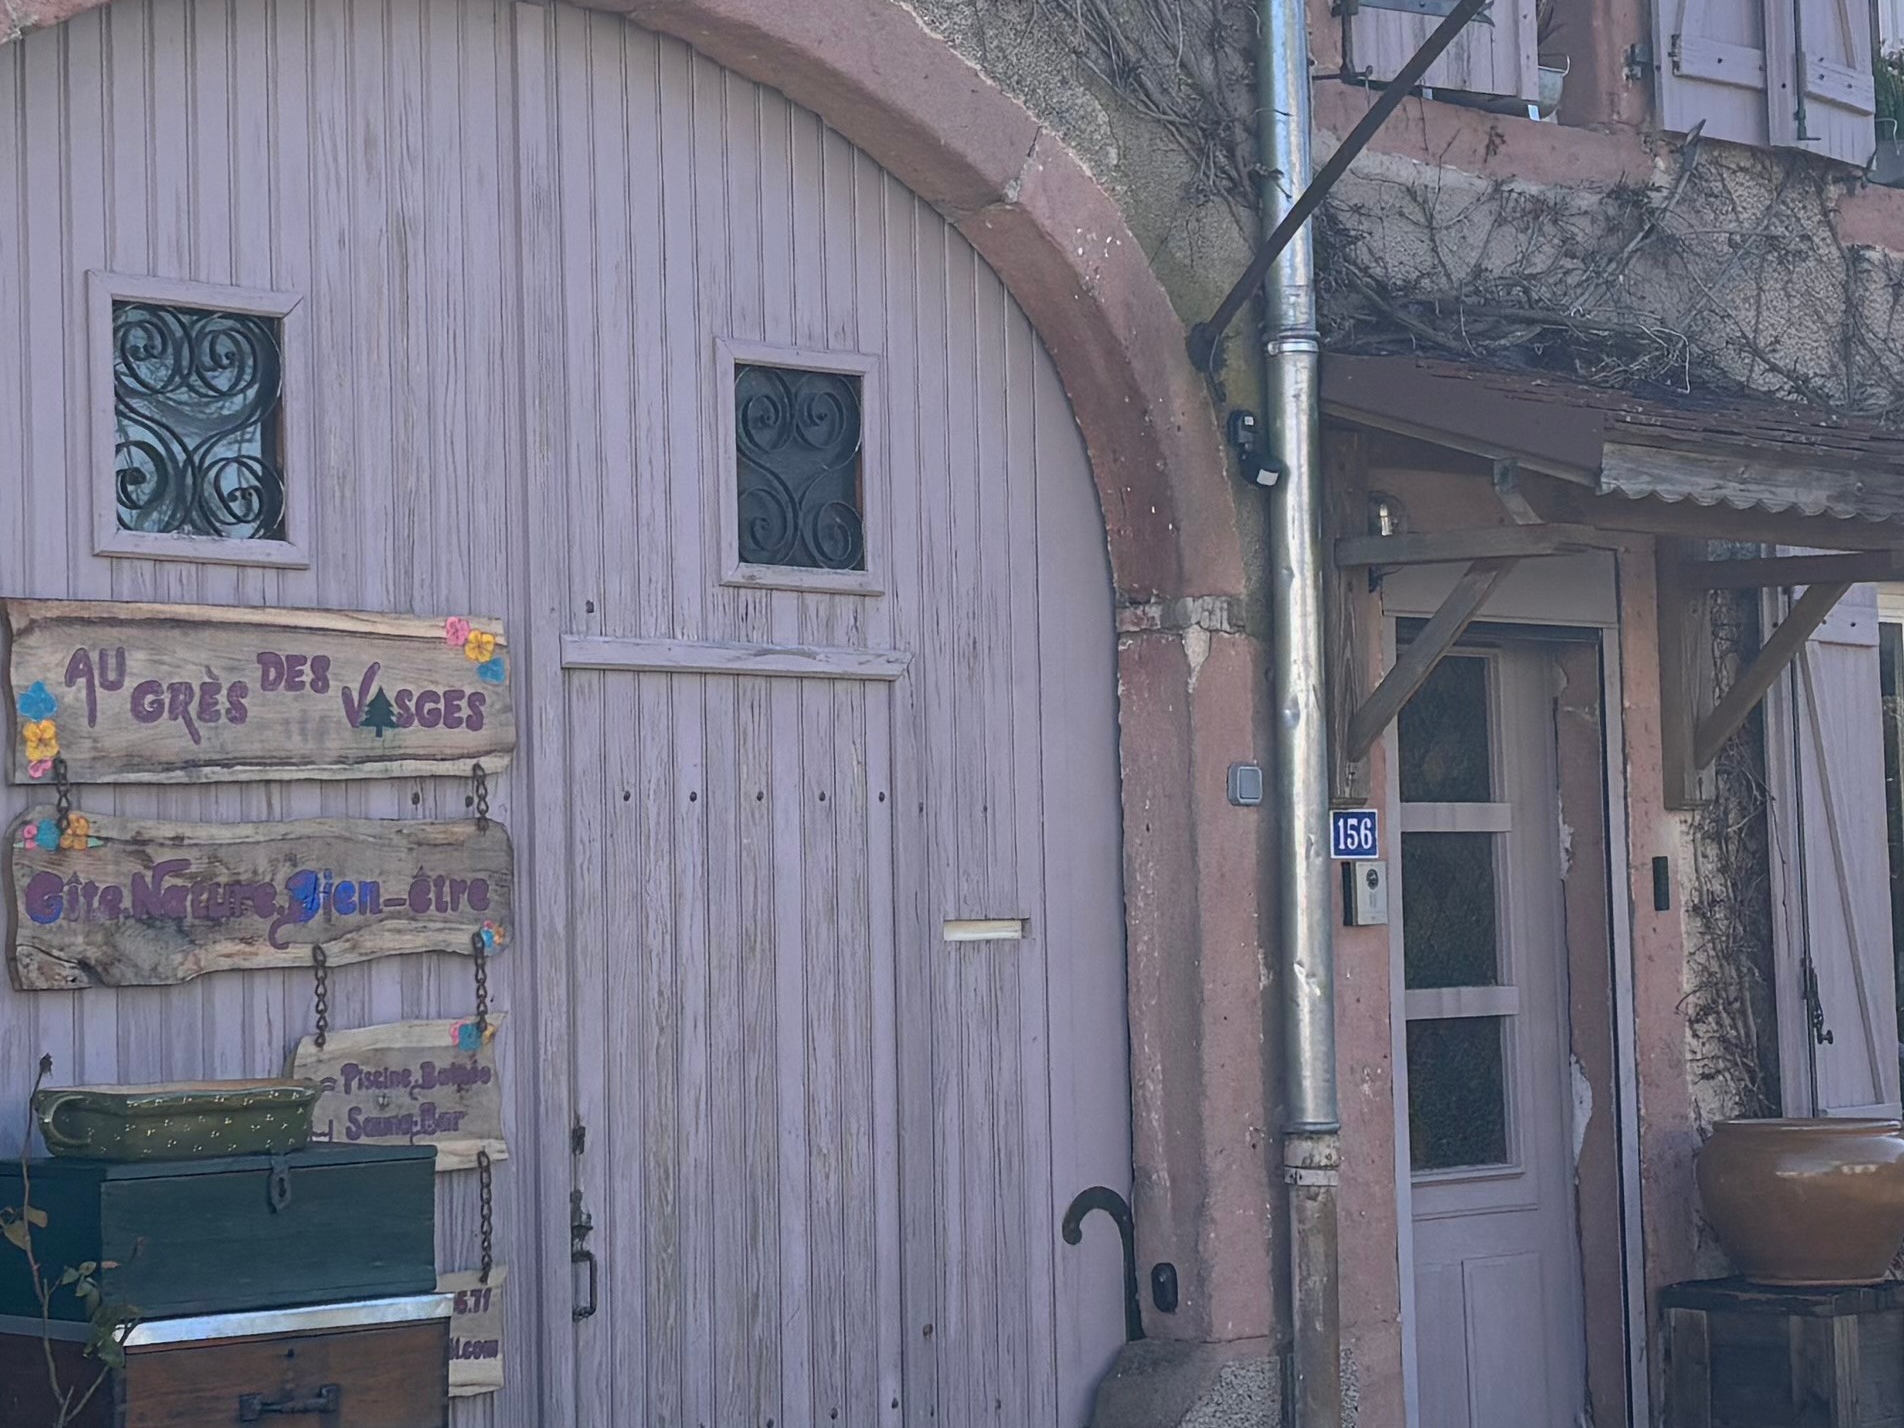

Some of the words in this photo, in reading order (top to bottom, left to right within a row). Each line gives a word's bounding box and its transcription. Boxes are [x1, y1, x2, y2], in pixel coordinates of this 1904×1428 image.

[64, 646, 127, 728] AU
[130, 665, 249, 745] GRÈS
[256, 651, 331, 694] DES
[341, 661, 486, 738] VSGES
[1337, 817, 1373, 850] 156
